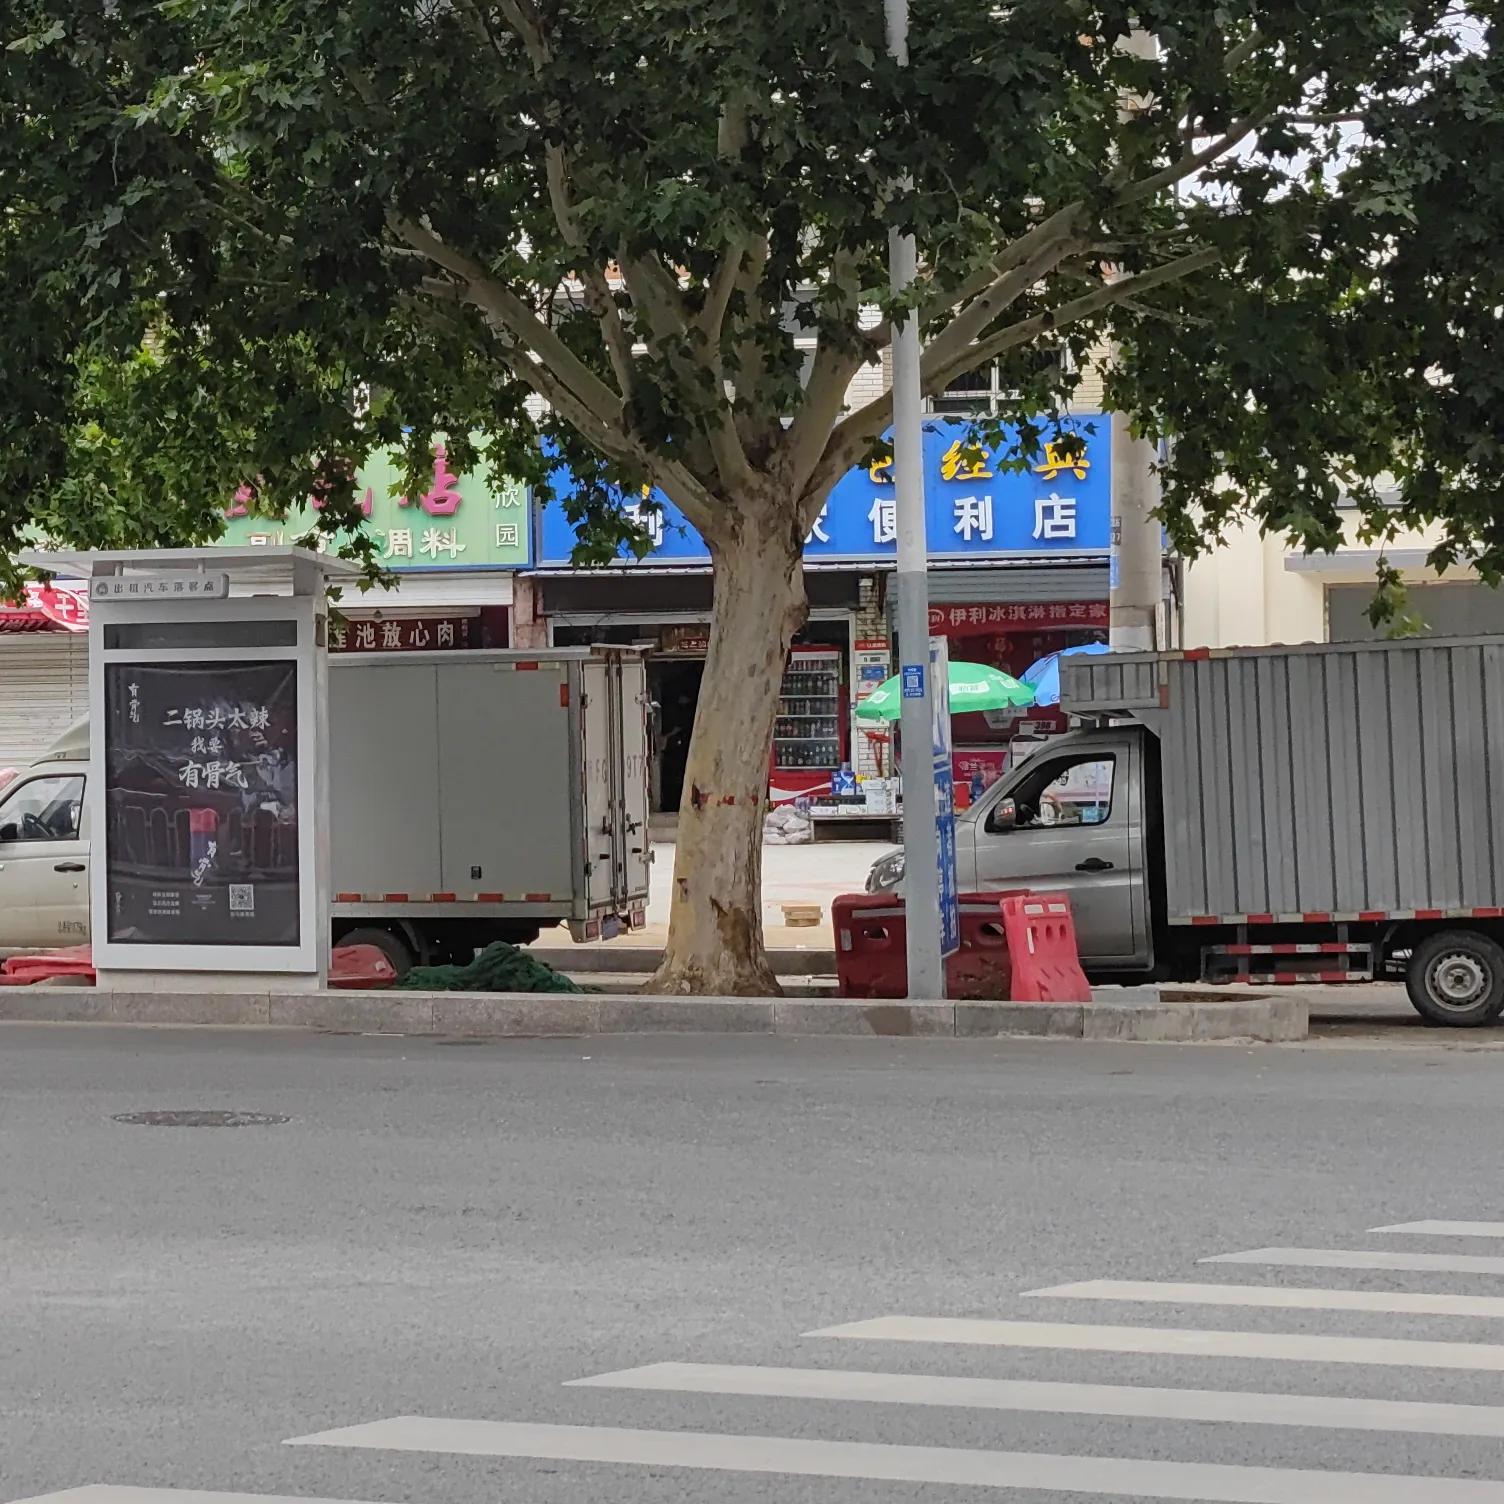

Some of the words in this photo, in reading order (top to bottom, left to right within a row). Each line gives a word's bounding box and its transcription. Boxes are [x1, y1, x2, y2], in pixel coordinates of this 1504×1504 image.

[162, 705, 272, 730] 二锅头太辣
[191, 736, 224, 754] 我要
[178, 760, 249, 789] 有骨气
